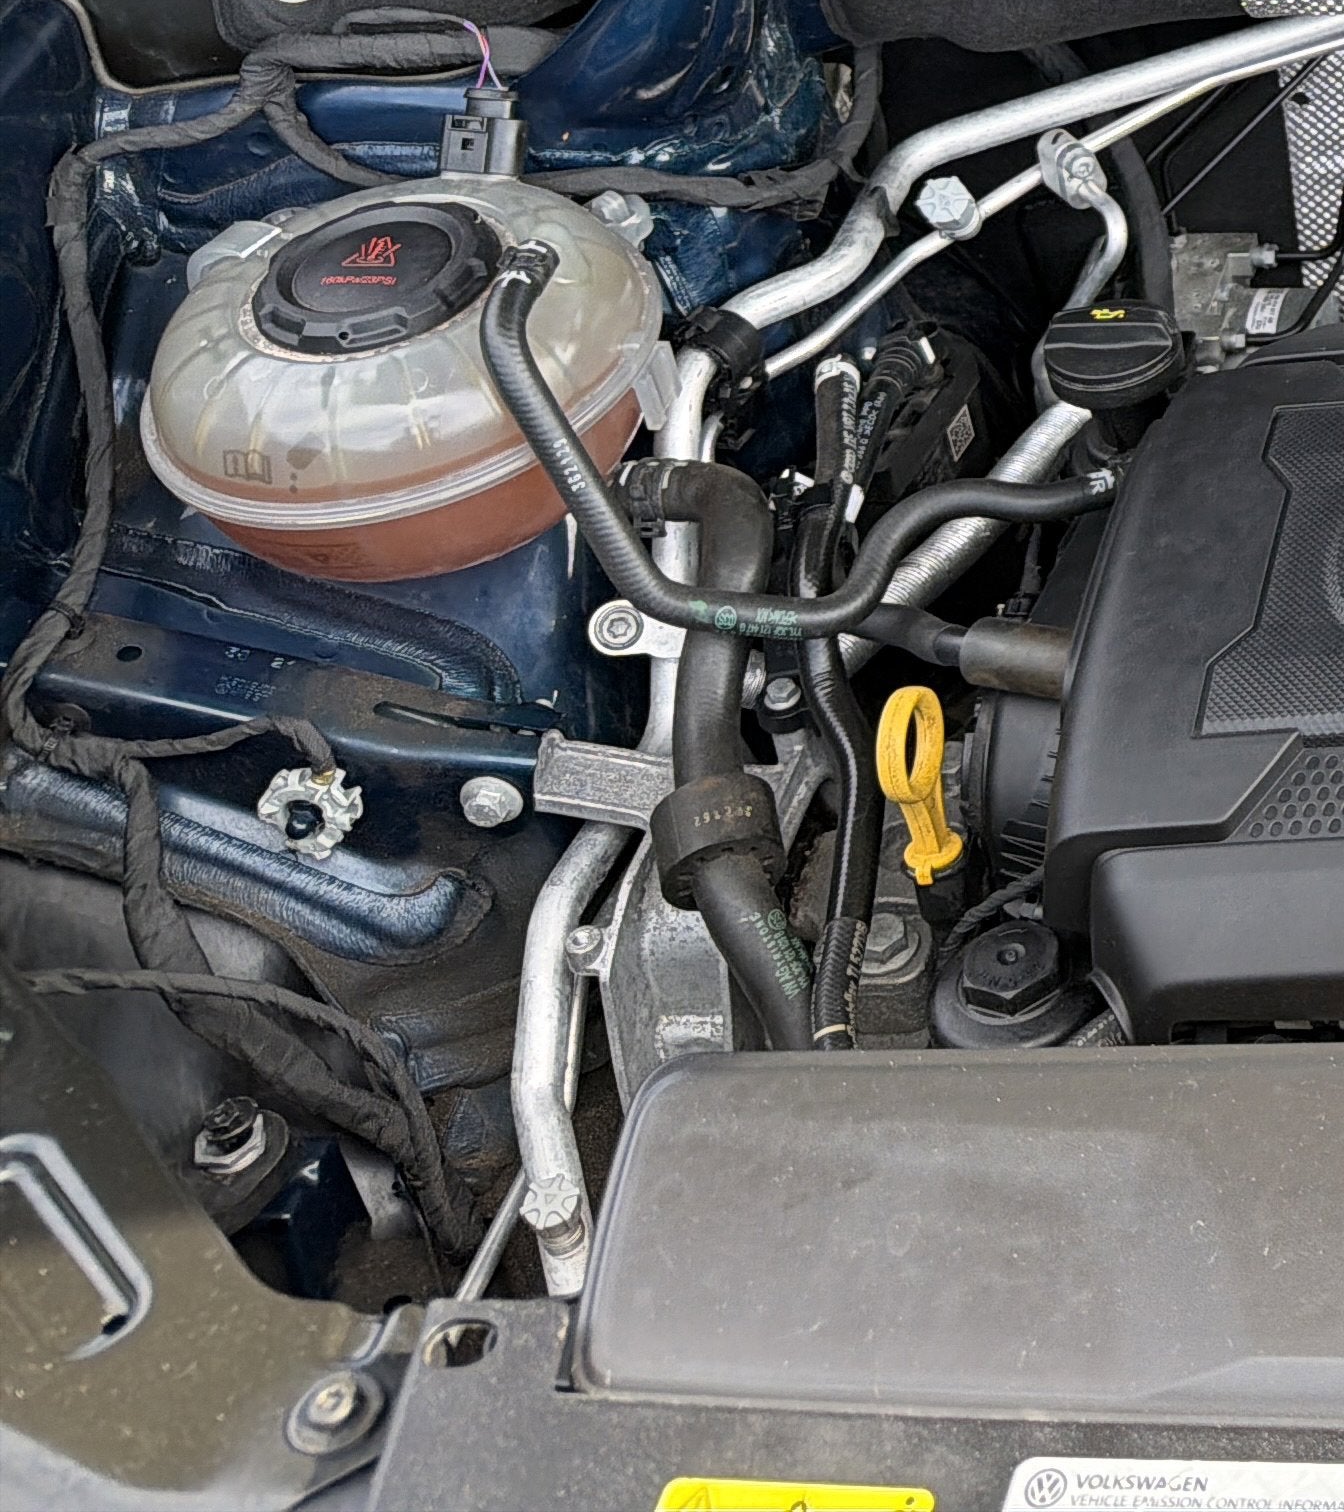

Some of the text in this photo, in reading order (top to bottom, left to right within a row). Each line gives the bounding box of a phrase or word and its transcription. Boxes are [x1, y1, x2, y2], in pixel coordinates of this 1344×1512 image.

[1076, 1473, 1209, 1492] VOLKSWAGEN
[1070, 1495, 1129, 1507] VEHICLE
[1132, 1496, 1203, 1509] EMISSION
[1206, 1497, 1273, 1510] CONTROL
